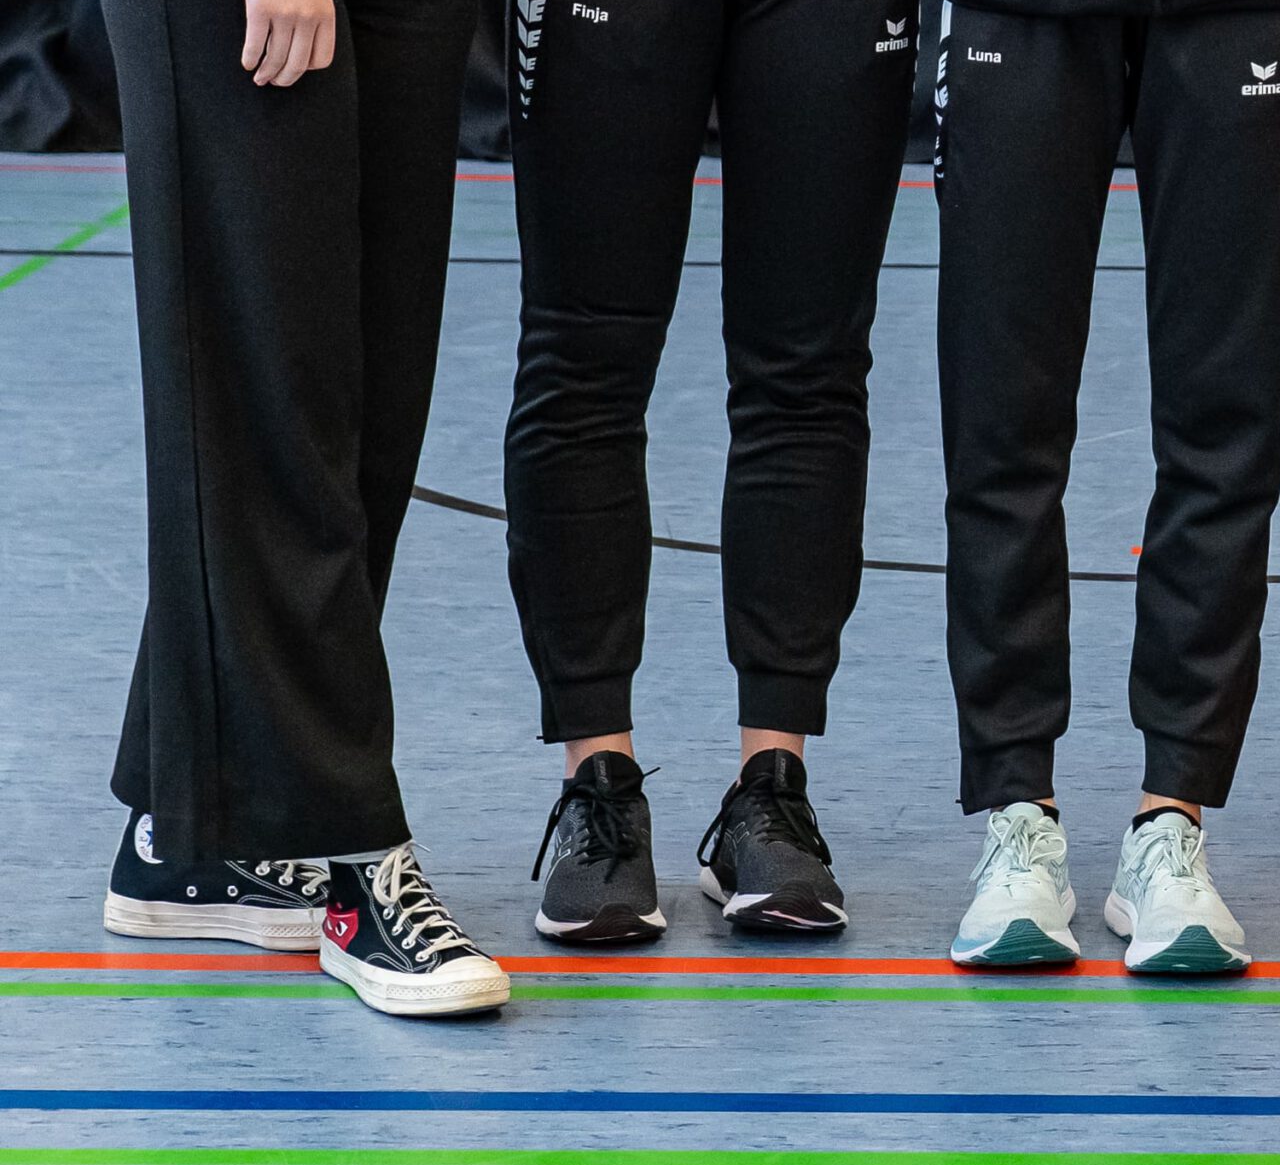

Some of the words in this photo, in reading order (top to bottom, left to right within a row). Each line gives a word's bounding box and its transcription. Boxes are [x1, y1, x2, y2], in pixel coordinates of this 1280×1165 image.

[573, 2, 609, 23] Finja
[875, 37, 909, 53] erima
[968, 47, 1002, 64] Luna
